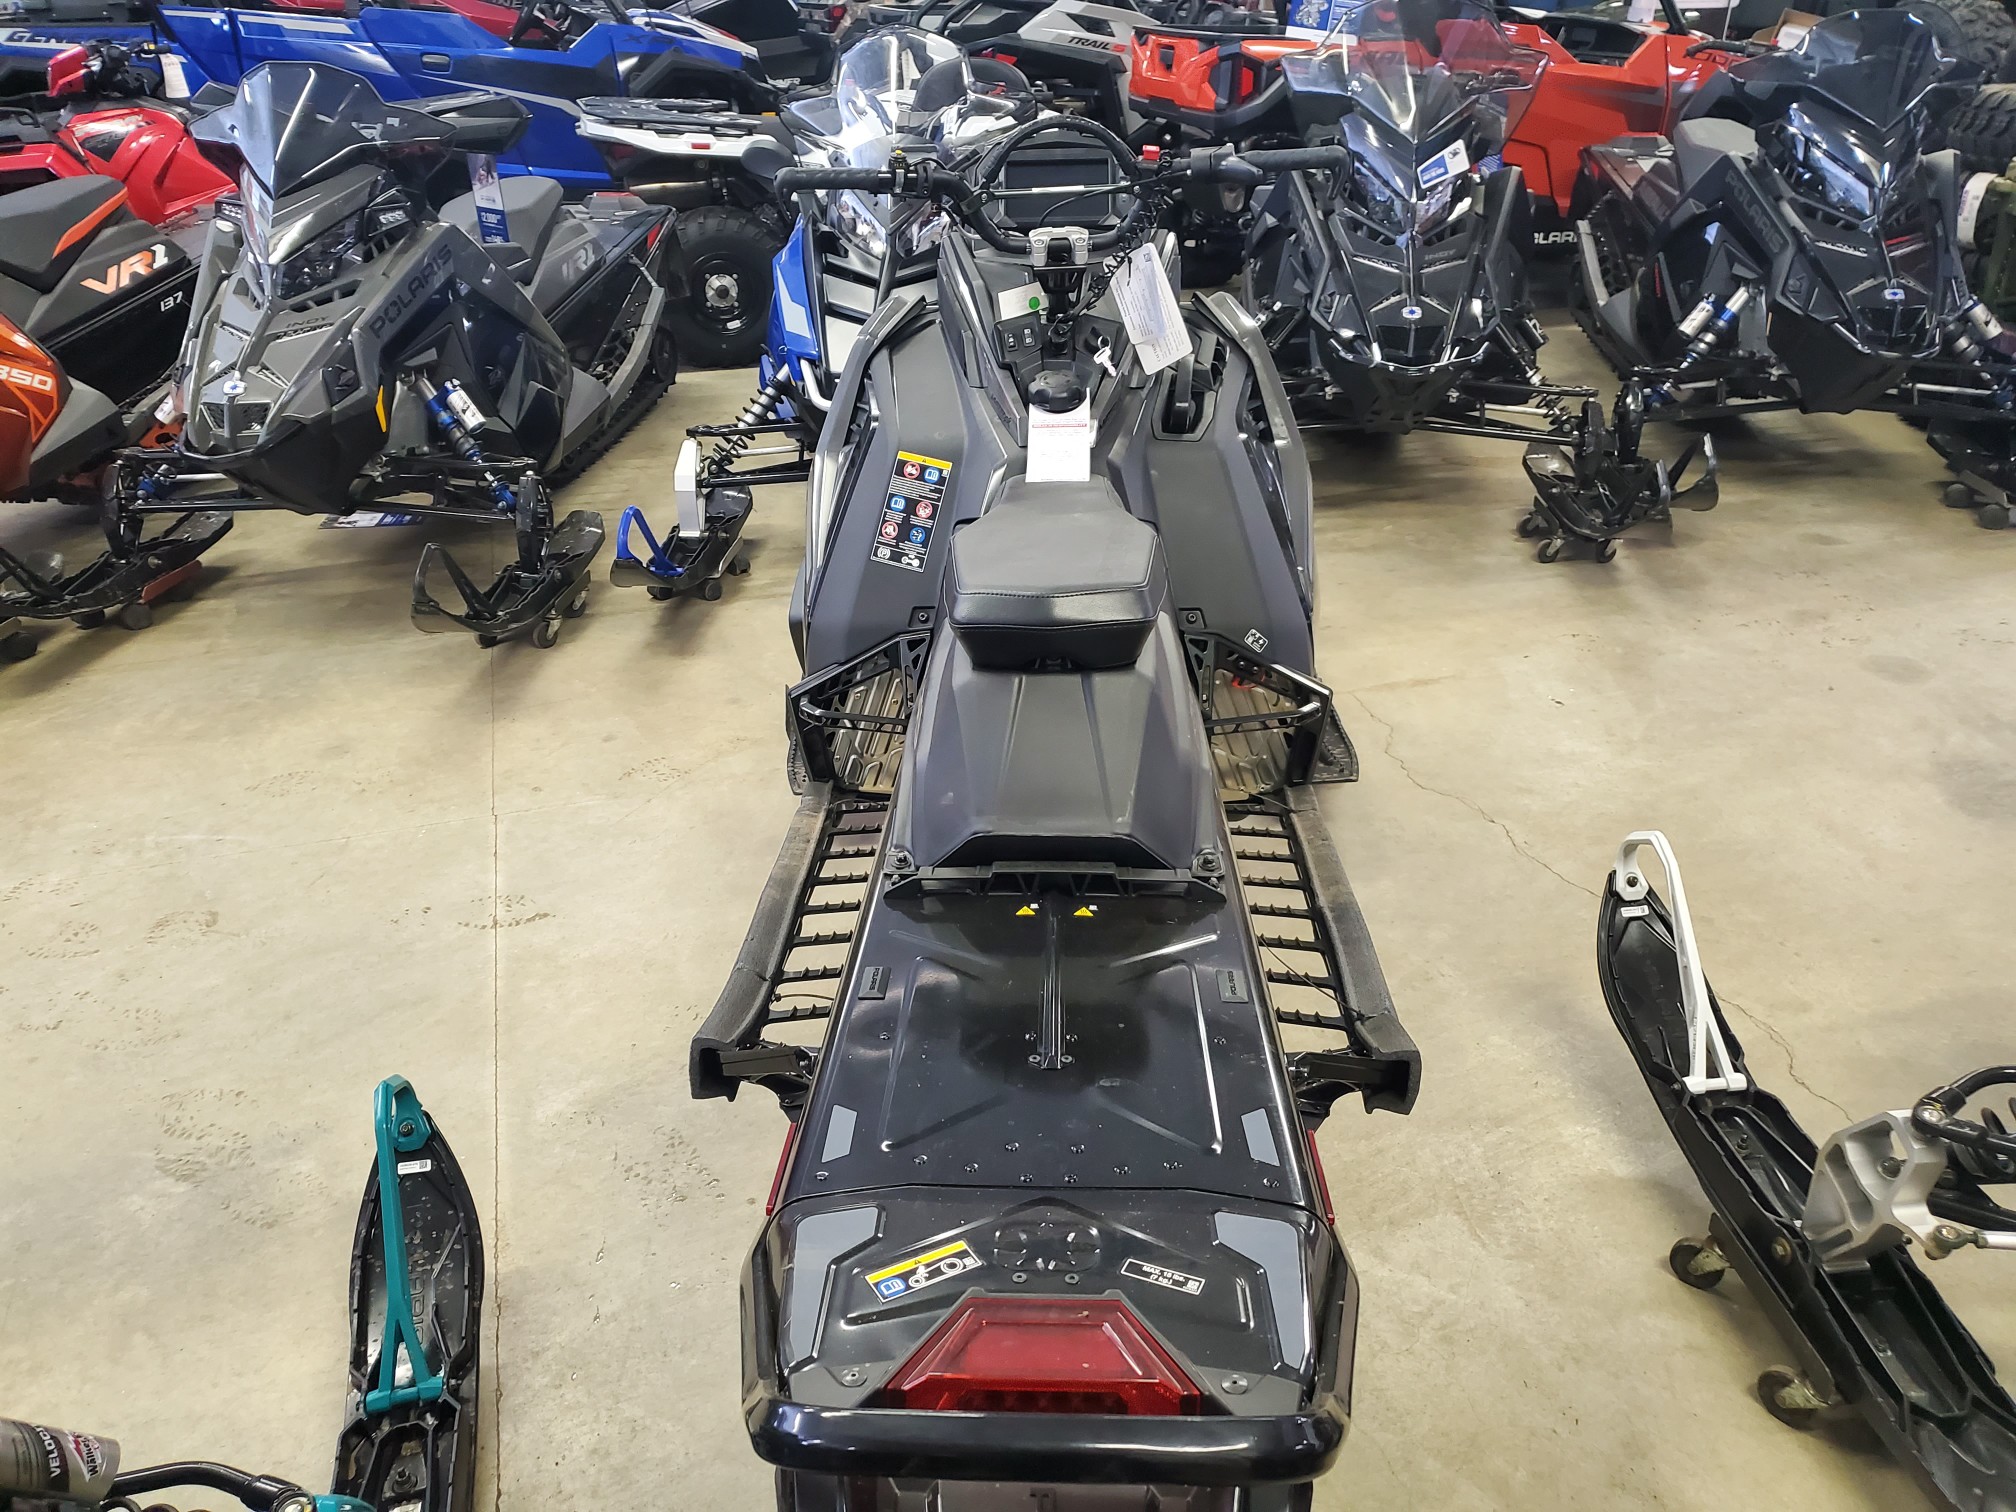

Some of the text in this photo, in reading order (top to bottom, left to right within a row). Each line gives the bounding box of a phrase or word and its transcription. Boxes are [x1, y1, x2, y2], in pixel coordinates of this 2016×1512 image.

[1068, 36, 1110, 50] TRAIL
[80, 243, 168, 295] VR1
[369, 243, 453, 339] POLARIS
[160, 291, 184, 312] 137
[285, 316, 327, 328] INDY
[1142, 1265, 1161, 1275] MAX.
